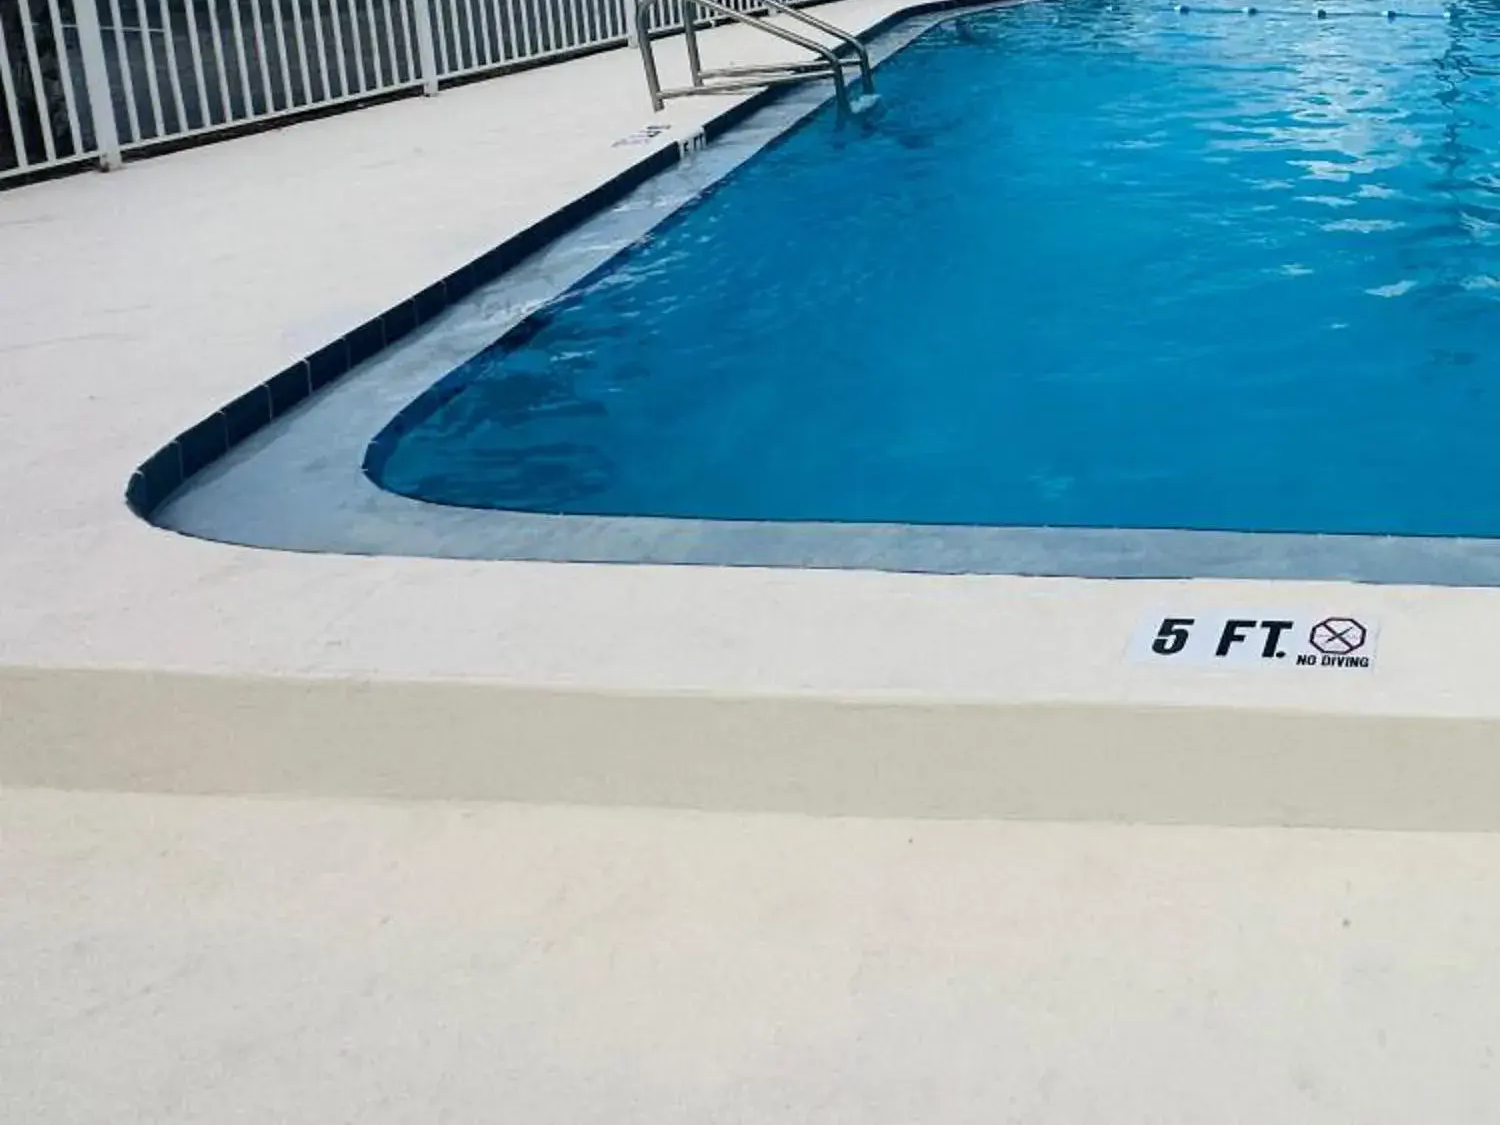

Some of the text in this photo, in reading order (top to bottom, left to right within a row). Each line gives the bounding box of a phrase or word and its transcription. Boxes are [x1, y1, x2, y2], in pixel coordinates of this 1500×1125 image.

[1151, 618, 1294, 659] 5 FT.
[1296, 654, 1369, 668] NO DIVING
